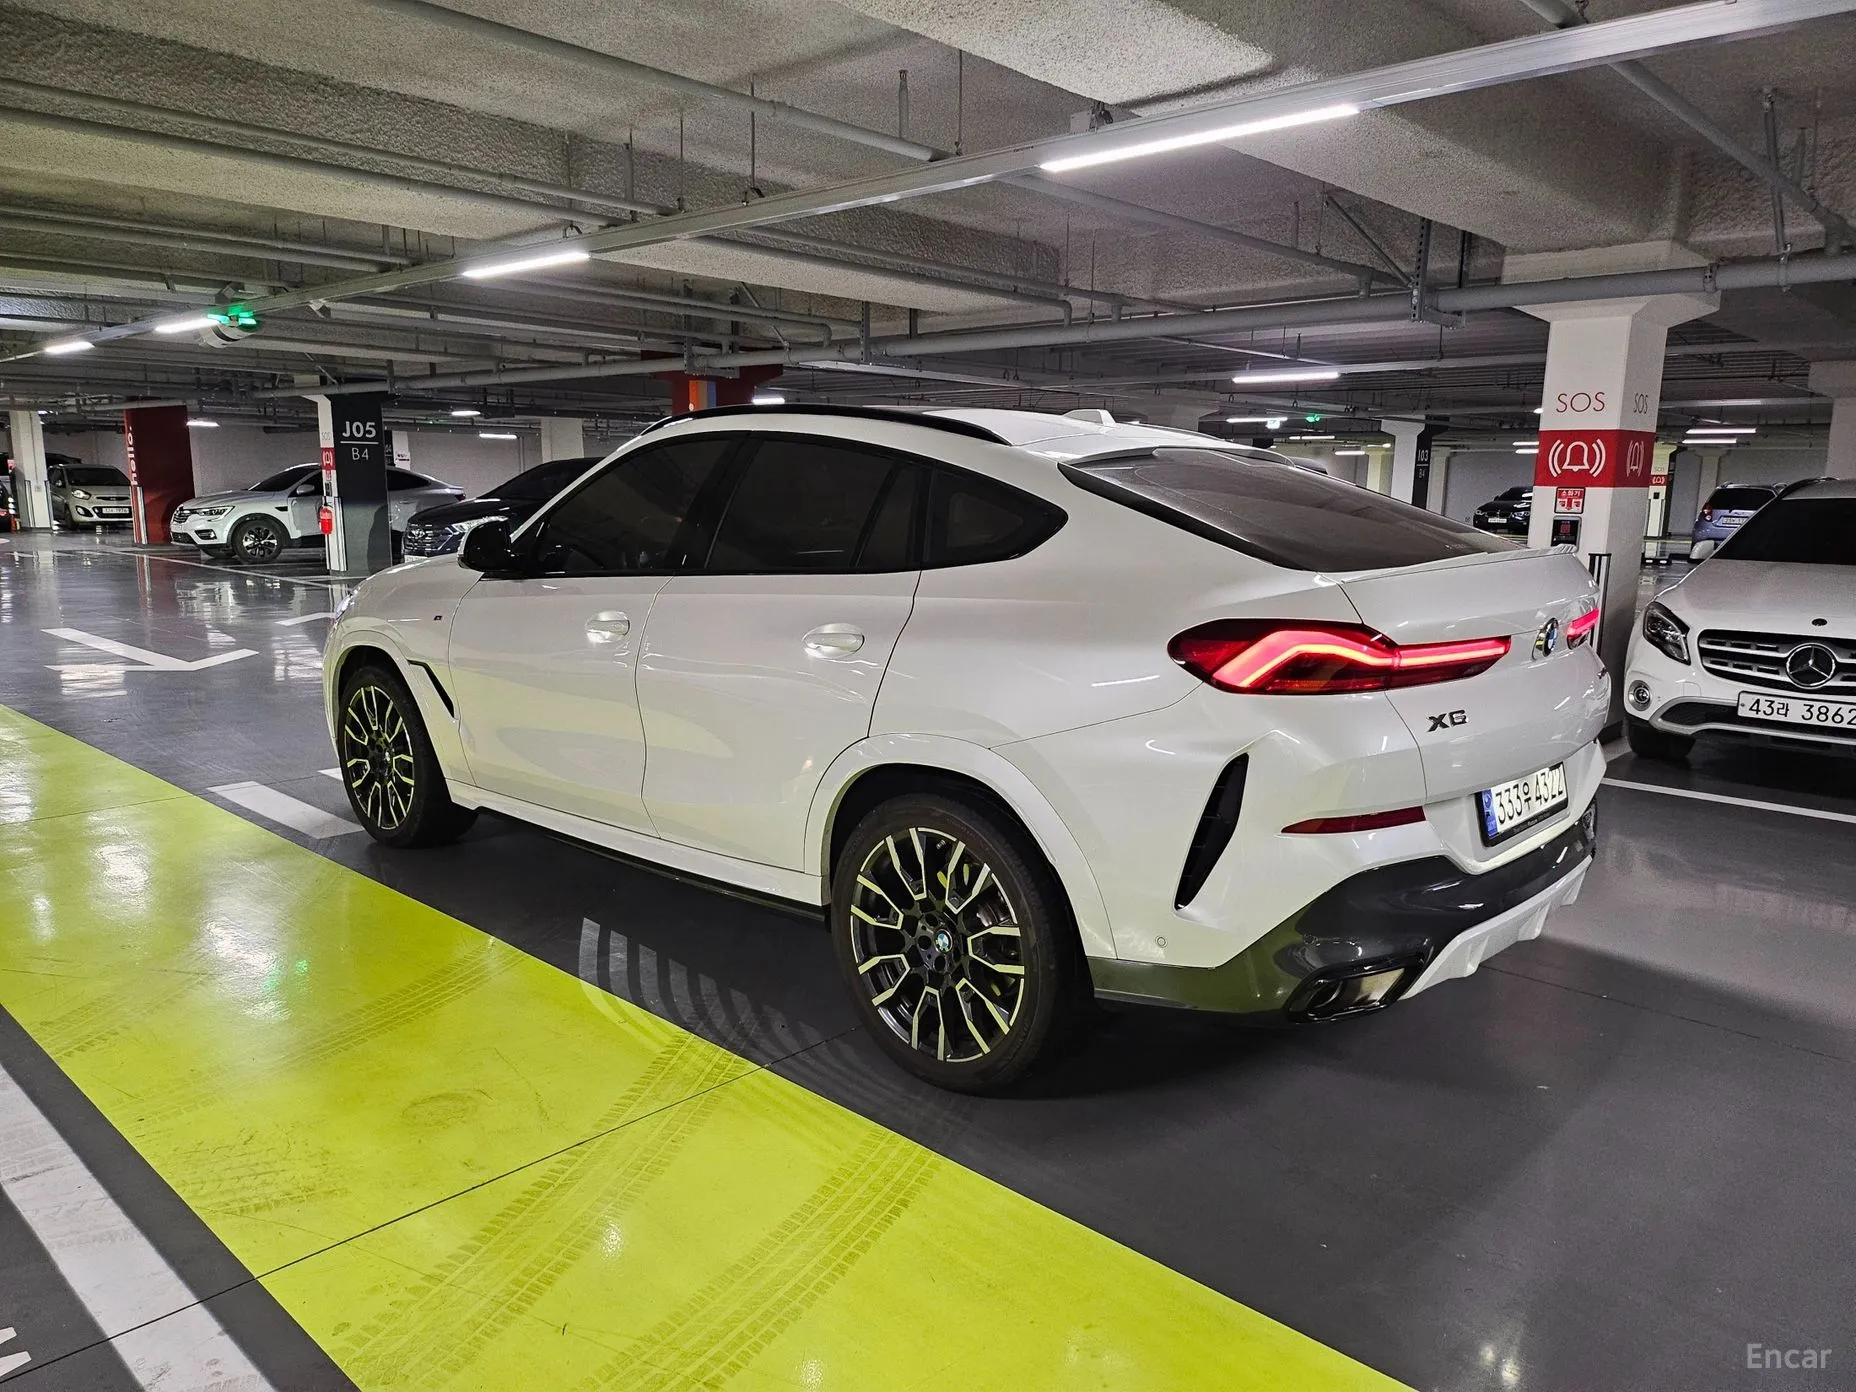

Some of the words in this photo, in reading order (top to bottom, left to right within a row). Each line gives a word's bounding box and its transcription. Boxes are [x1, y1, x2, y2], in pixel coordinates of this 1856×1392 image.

[1556, 391, 1606, 413] SOS
[1633, 393, 1649, 414] SOS
[342, 421, 377, 438] J05
[351, 447, 370, 460] B4
[1427, 710, 1468, 732] X6
[1748, 698, 1790, 718] 43라
[1801, 703, 1856, 726] 3862
